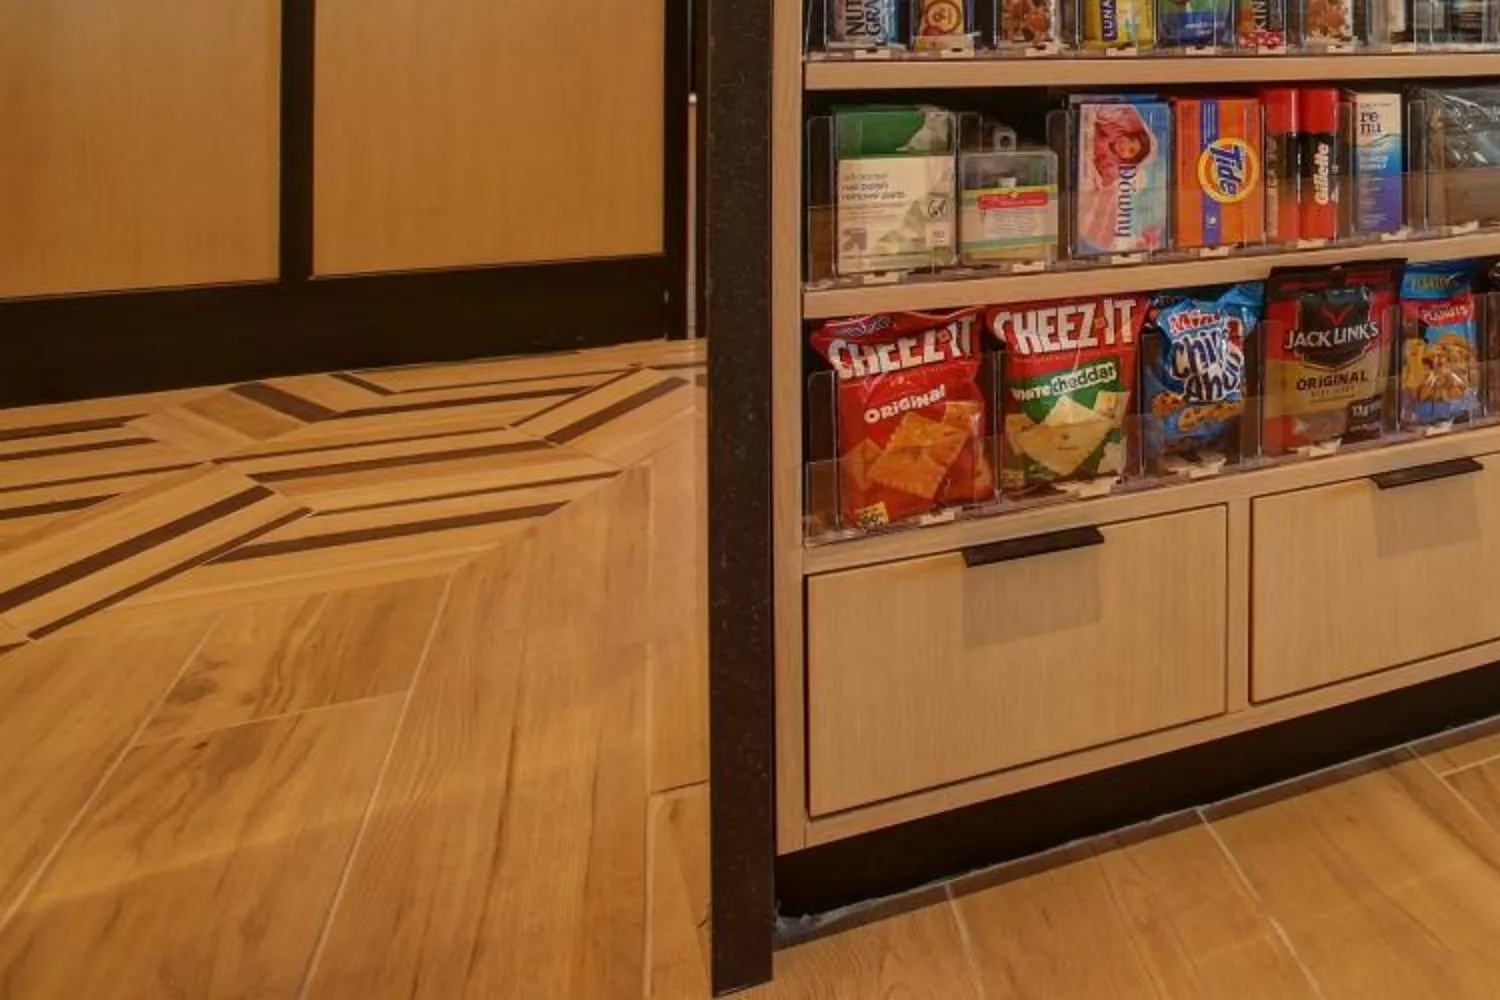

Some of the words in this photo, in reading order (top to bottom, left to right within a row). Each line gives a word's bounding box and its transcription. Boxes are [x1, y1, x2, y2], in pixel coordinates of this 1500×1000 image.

[1209, 143, 1243, 195] Tide
[1114, 164, 1137, 237] Downy
[1284, 329, 1333, 350] JACK
[1295, 370, 1369, 392] ORIGINAL
